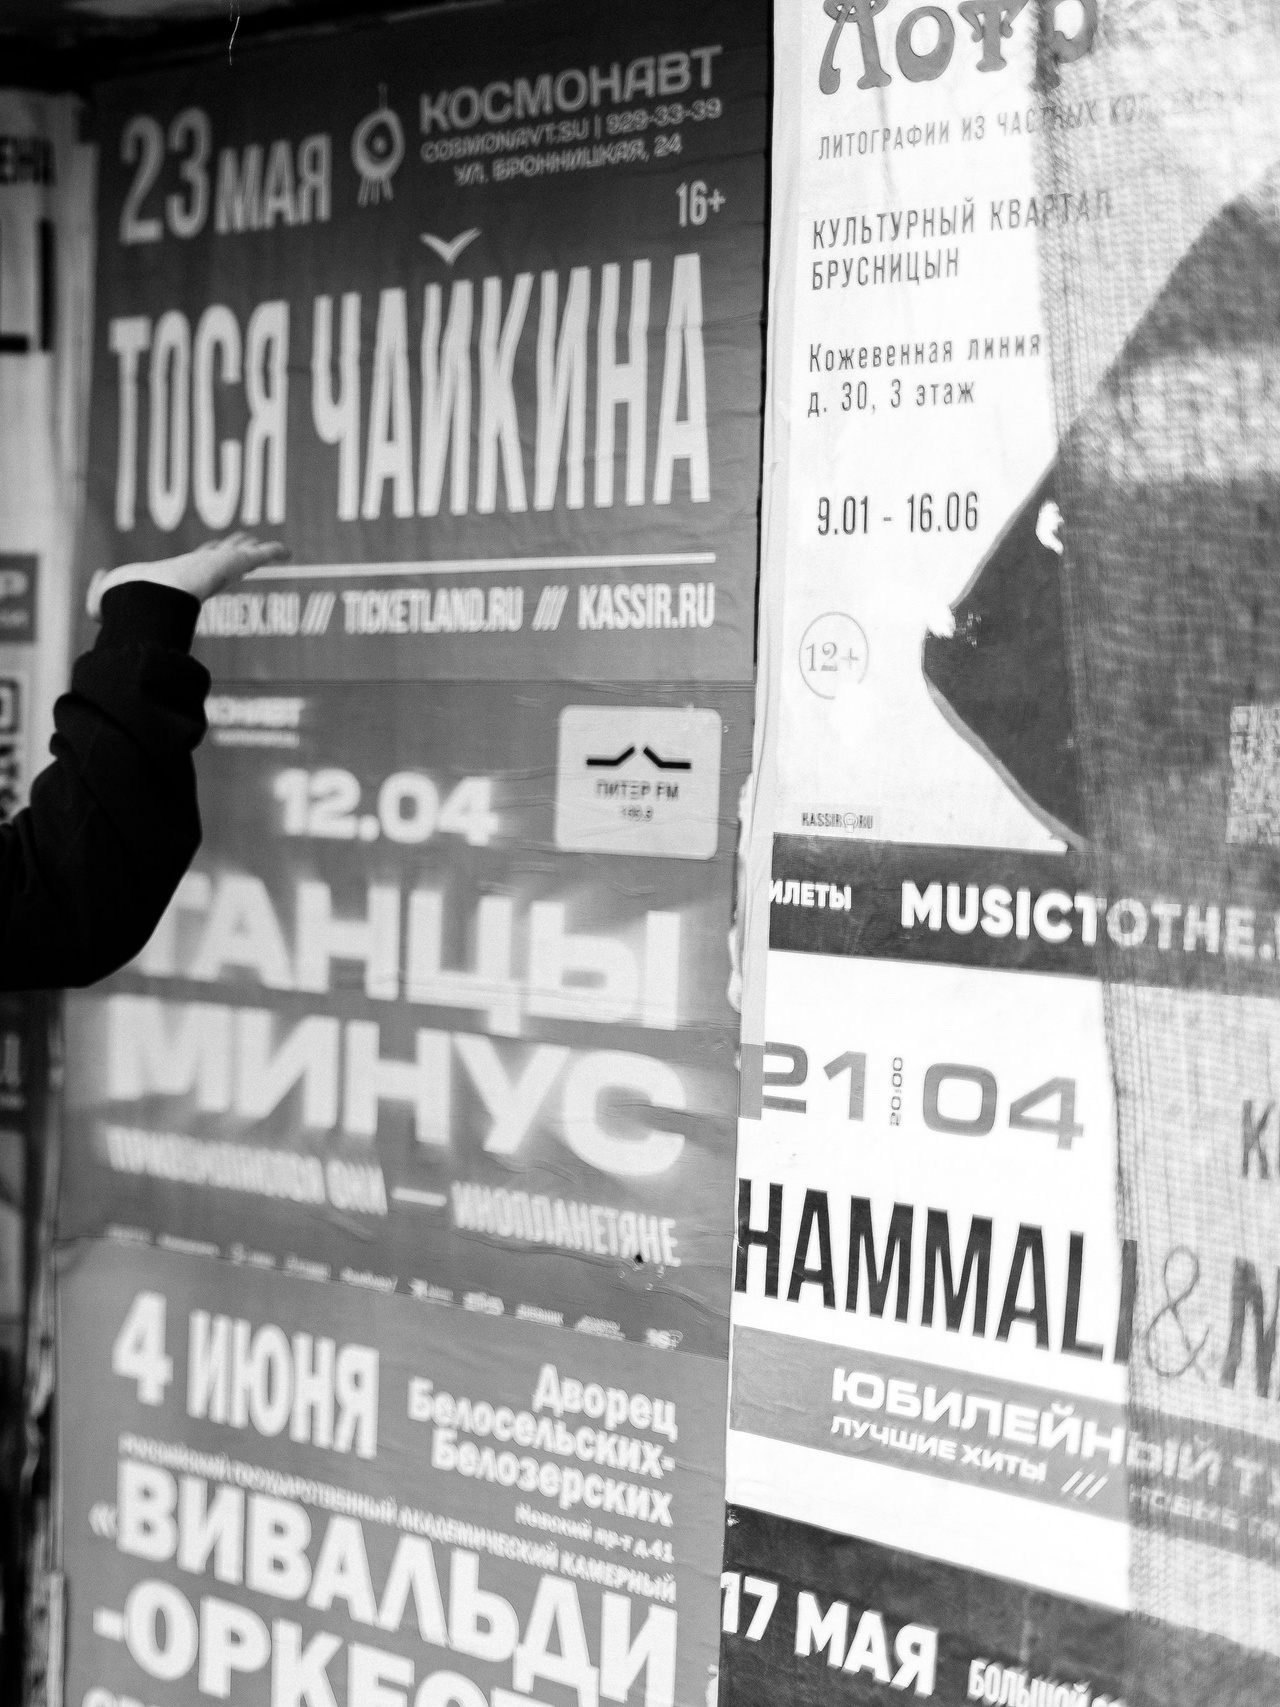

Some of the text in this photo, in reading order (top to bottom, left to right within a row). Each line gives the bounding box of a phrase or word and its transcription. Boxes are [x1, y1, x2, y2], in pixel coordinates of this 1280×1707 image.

[420, 45, 723, 134] КОСМОНАВТ
[120, 105, 332, 245] 23 МАЯ
[818, 117, 951, 161] ЛИТОГРАФИИ
[961, 114, 986, 142] ИЗ
[676, 180, 726, 228] 16+
[813, 197, 976, 250] КУЛЬТУРНЫЙ
[811, 247, 961, 292] БРУСНИЦЫН
[808, 333, 1042, 373] Кожевенная линия
[109, 299, 290, 532] ТОСЯ
[807, 388, 828, 418] д.
[890, 378, 903, 409] 3
[915, 380, 976, 409] этаж
[817, 494, 870, 536] 9.01
[907, 491, 980, 533] 16.06
[578, 581, 716, 631] KASSIR.RU
[805, 639, 860, 673] 12+
[273, 767, 502, 848] 12.04
[901, 879, 1280, 961] MUSICTOTHE.
[106, 994, 687, 1177] МИНУС
[922, 1062, 1085, 1151] 04
[734, 1178, 1139, 1367] HAMMALI
[112, 1290, 380, 1460] 4 ИЮНЯ
[532, 1361, 678, 1443] Дворец
[407, 1375, 677, 1480] Белосельских-
[830, 1415, 956, 1462] ЛУЧШИЕ
[959, 1442, 1049, 1483] ХИТЫ
[831, 1367, 1222, 1487] ЮБИЛЕЙНЫЙ
[431, 1427, 675, 1528] Белозерских
[560, 1550, 678, 1604] КАМЕРНЫЙ
[720, 1570, 939, 1699] 17 МАЯ
